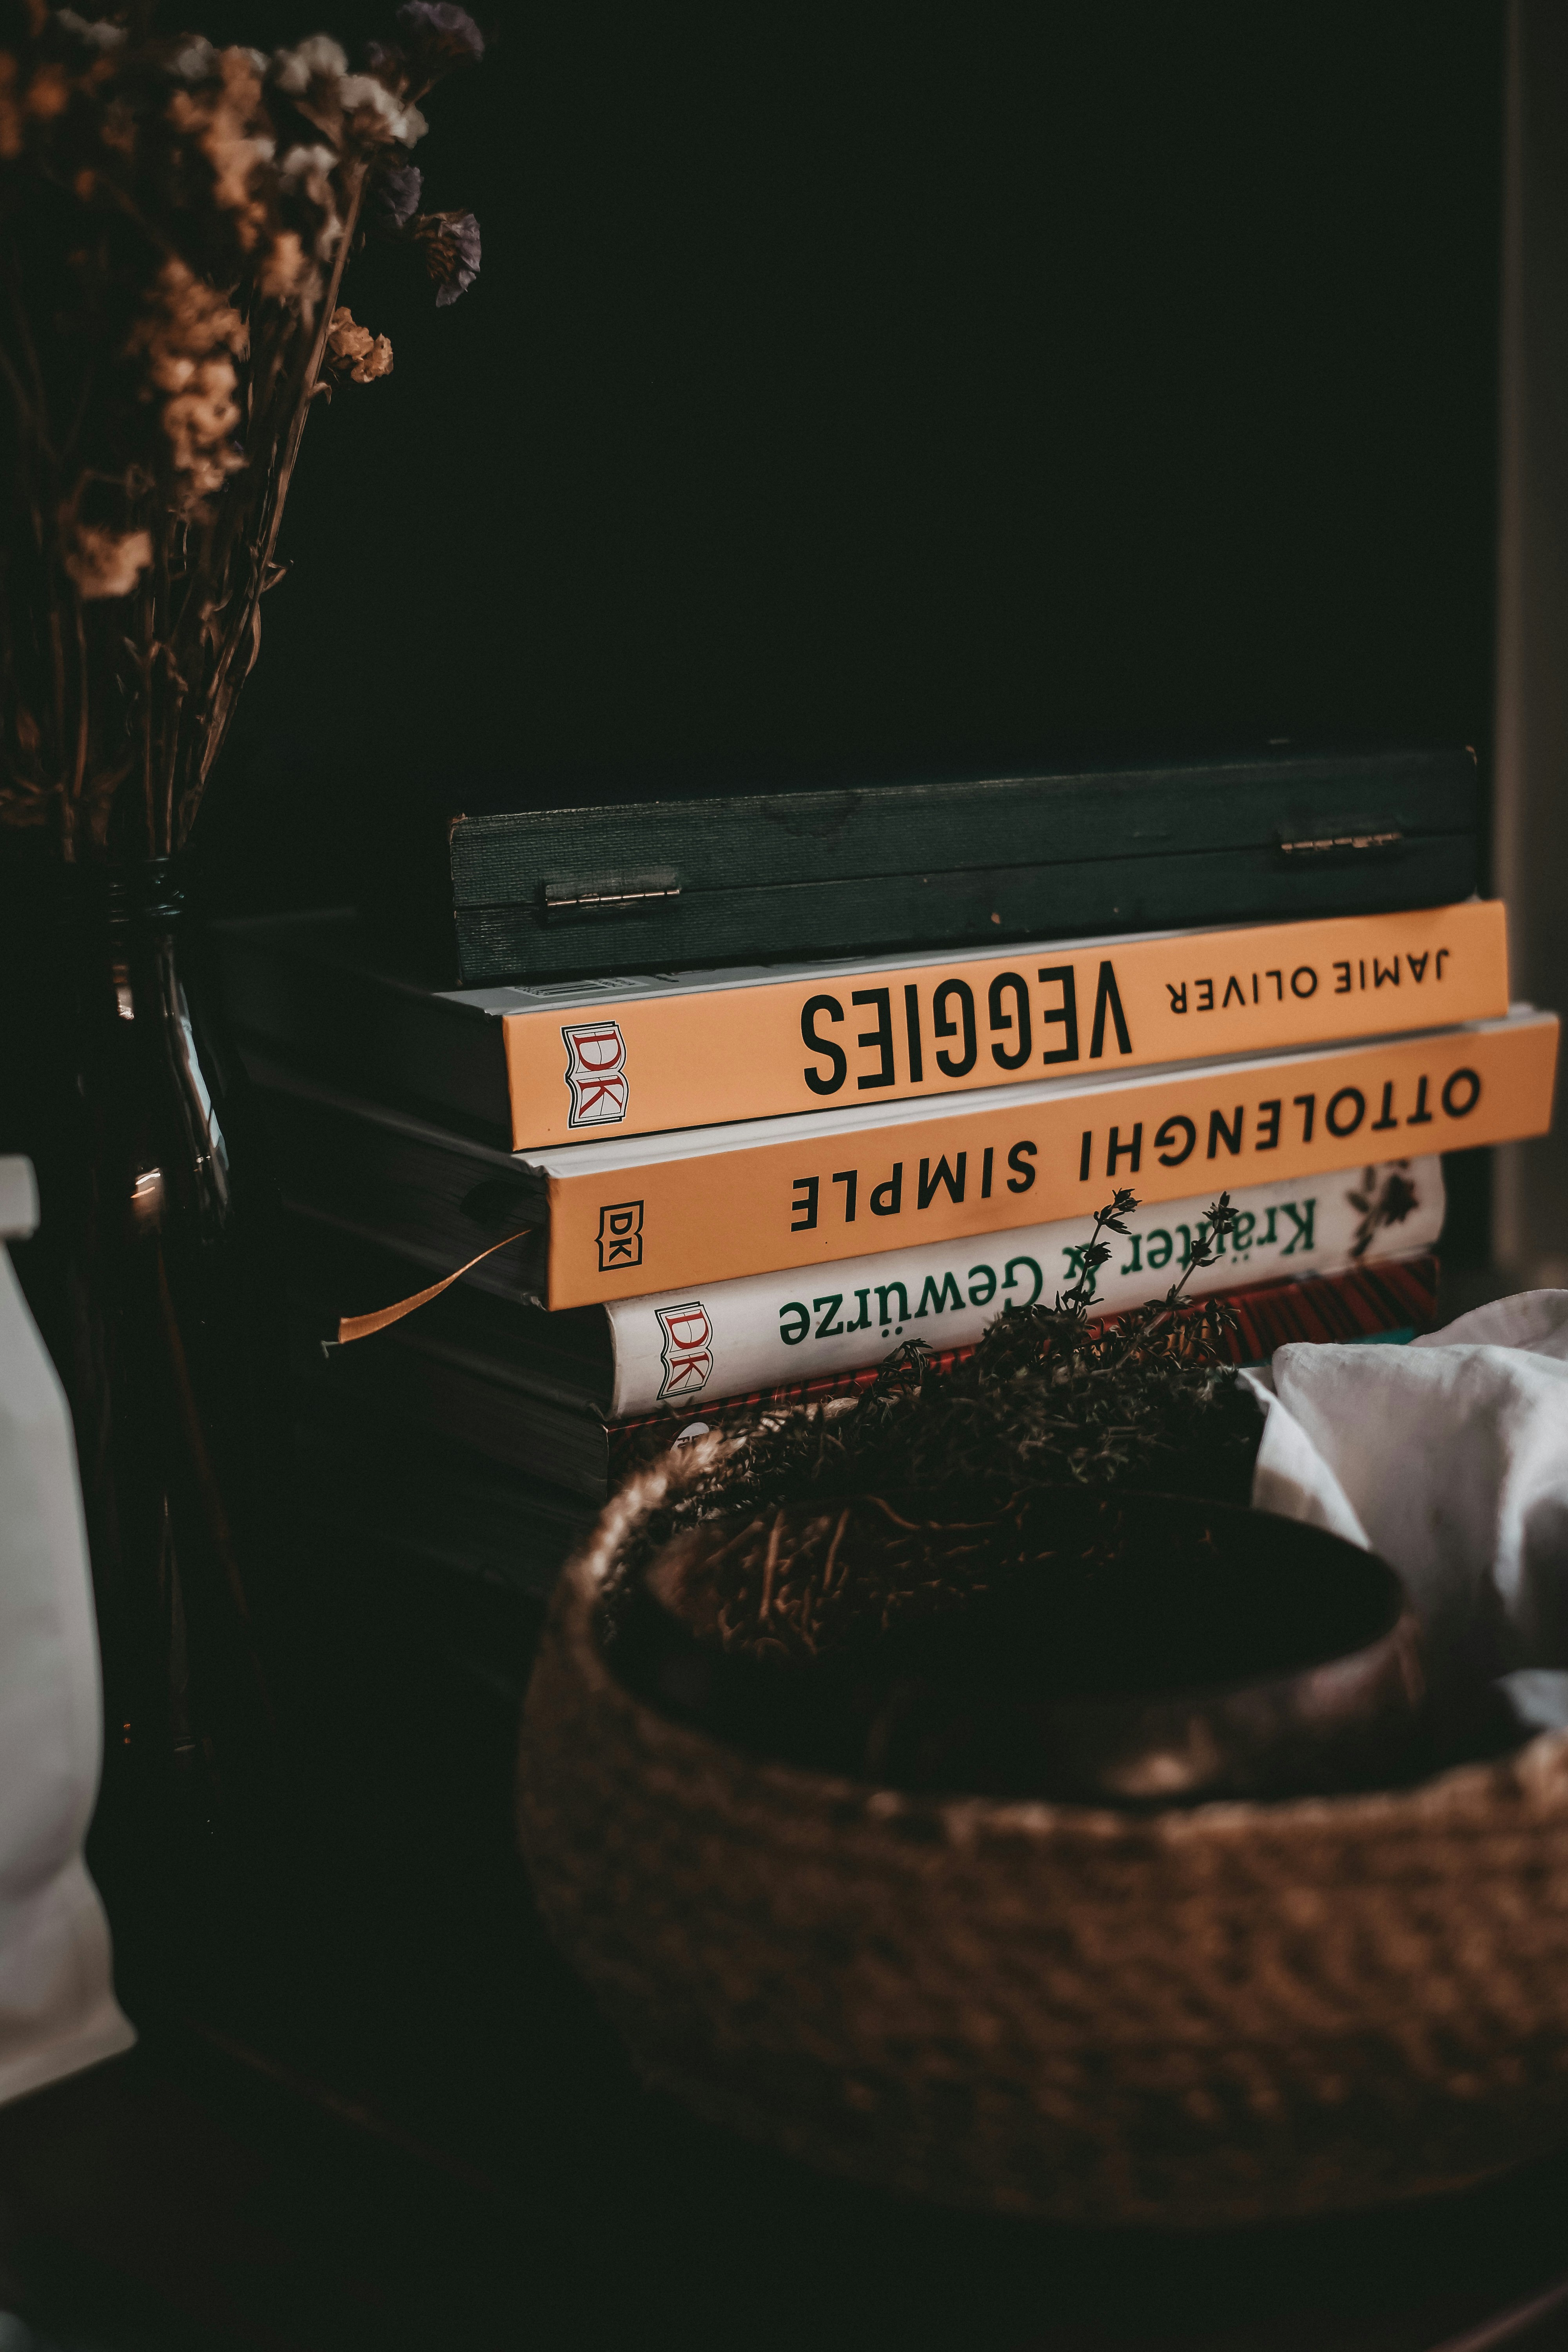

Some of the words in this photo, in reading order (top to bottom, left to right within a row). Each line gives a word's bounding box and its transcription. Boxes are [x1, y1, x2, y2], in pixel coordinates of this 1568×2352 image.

[1165, 966, 1318, 1014] OLIVER
[1333, 948, 1450, 994] JAMIE
[800, 960, 1132, 1096] VEGGIES
[573, 1030, 623, 1118] DK
[1079, 1068, 1481, 1181] OTTOLENGHI
[791, 1140, 1038, 1232] SIMPLE
[608, 1211, 634, 1263] DK
[1121, 1198, 1317, 1276] Kräuter
[779, 1256, 1044, 1346] Gewürze
[665, 1310, 710, 1388] DK
